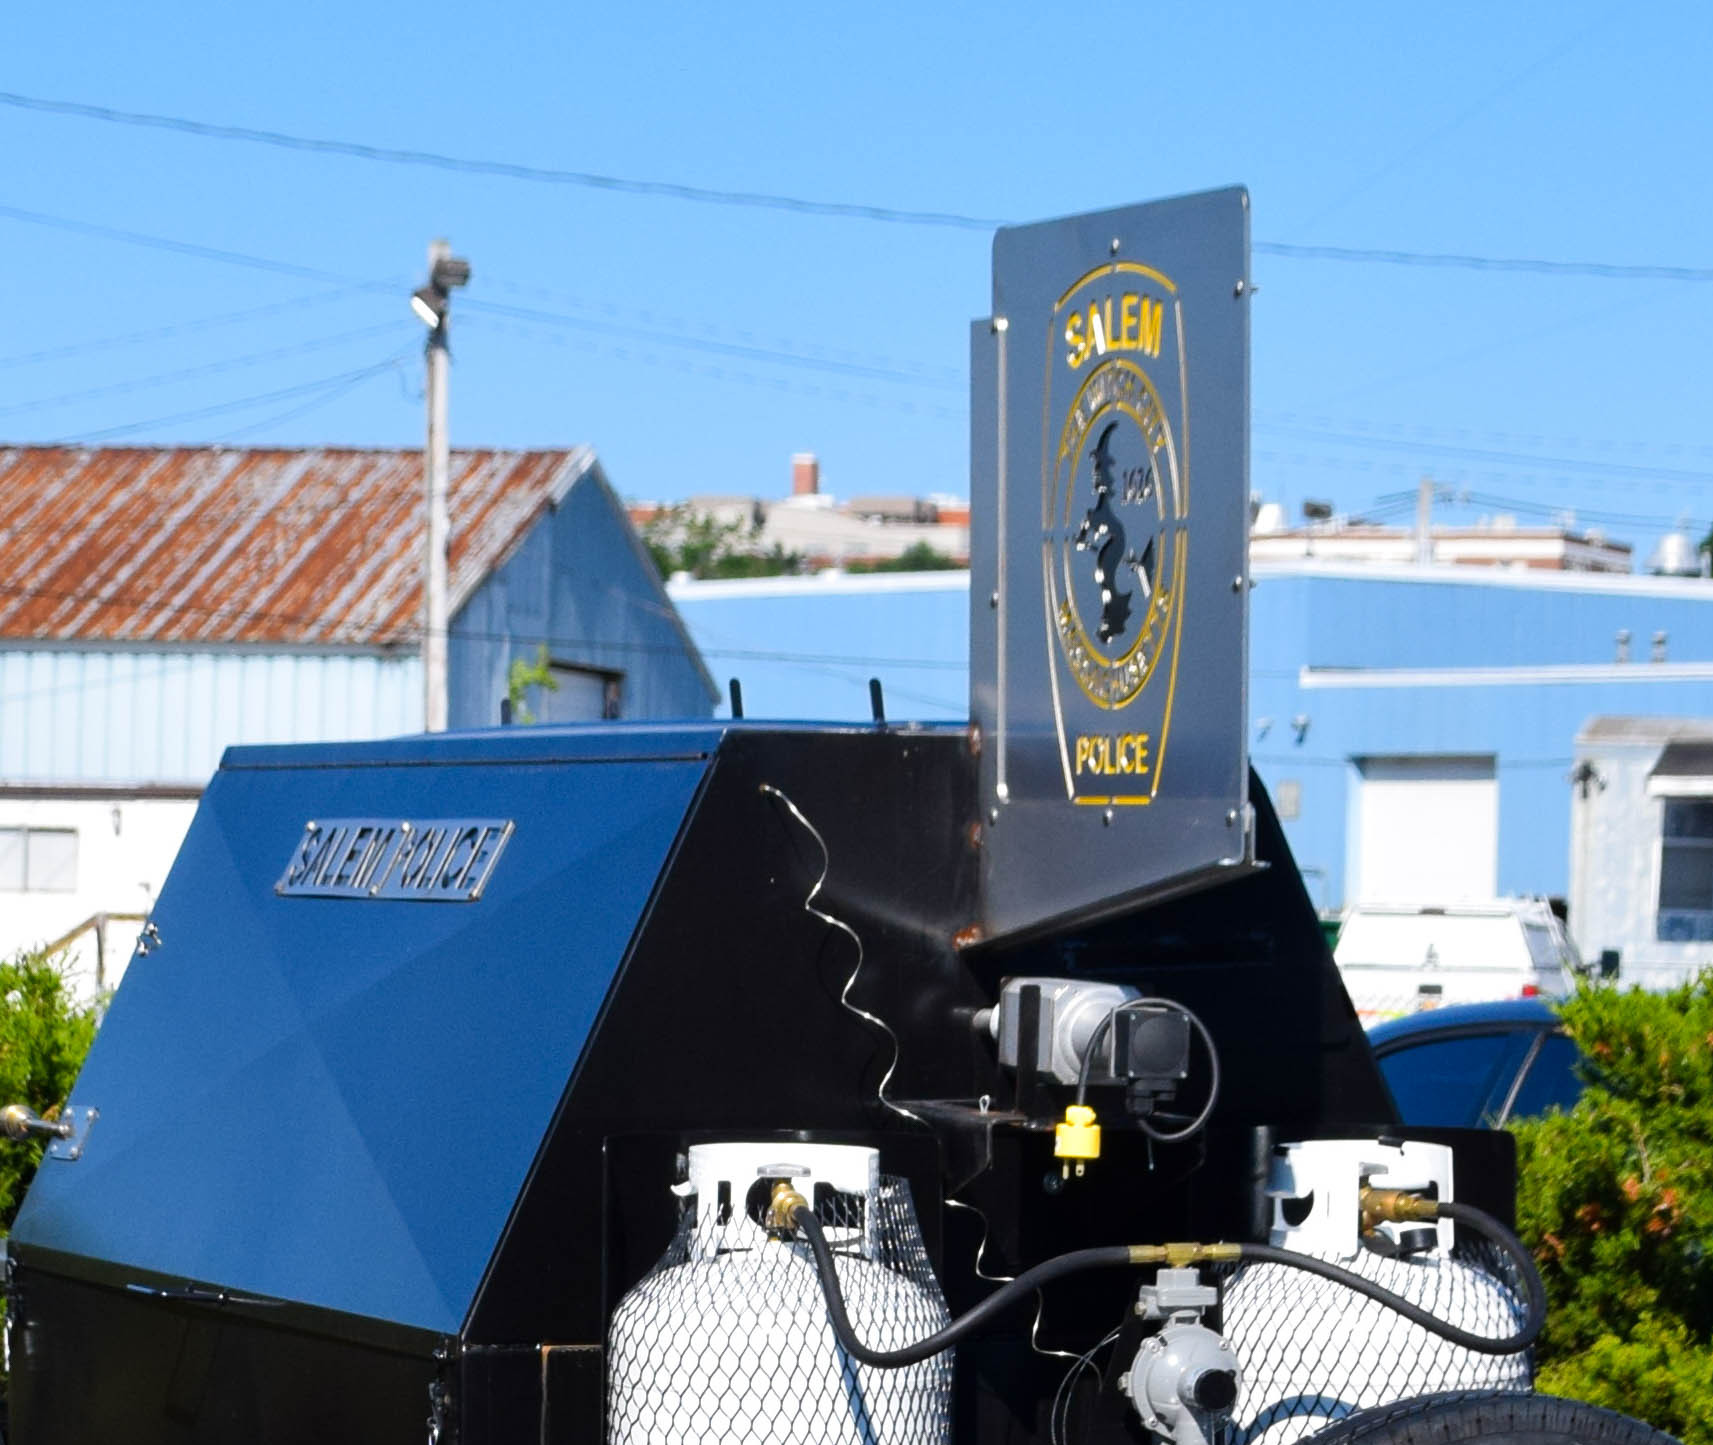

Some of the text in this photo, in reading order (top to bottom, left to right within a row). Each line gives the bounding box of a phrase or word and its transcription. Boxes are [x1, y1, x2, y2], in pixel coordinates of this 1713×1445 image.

[1065, 292, 1163, 369] SALEM
[1076, 732, 1149, 776] POLICE
[288, 826, 504, 889] SALEM POLICE
